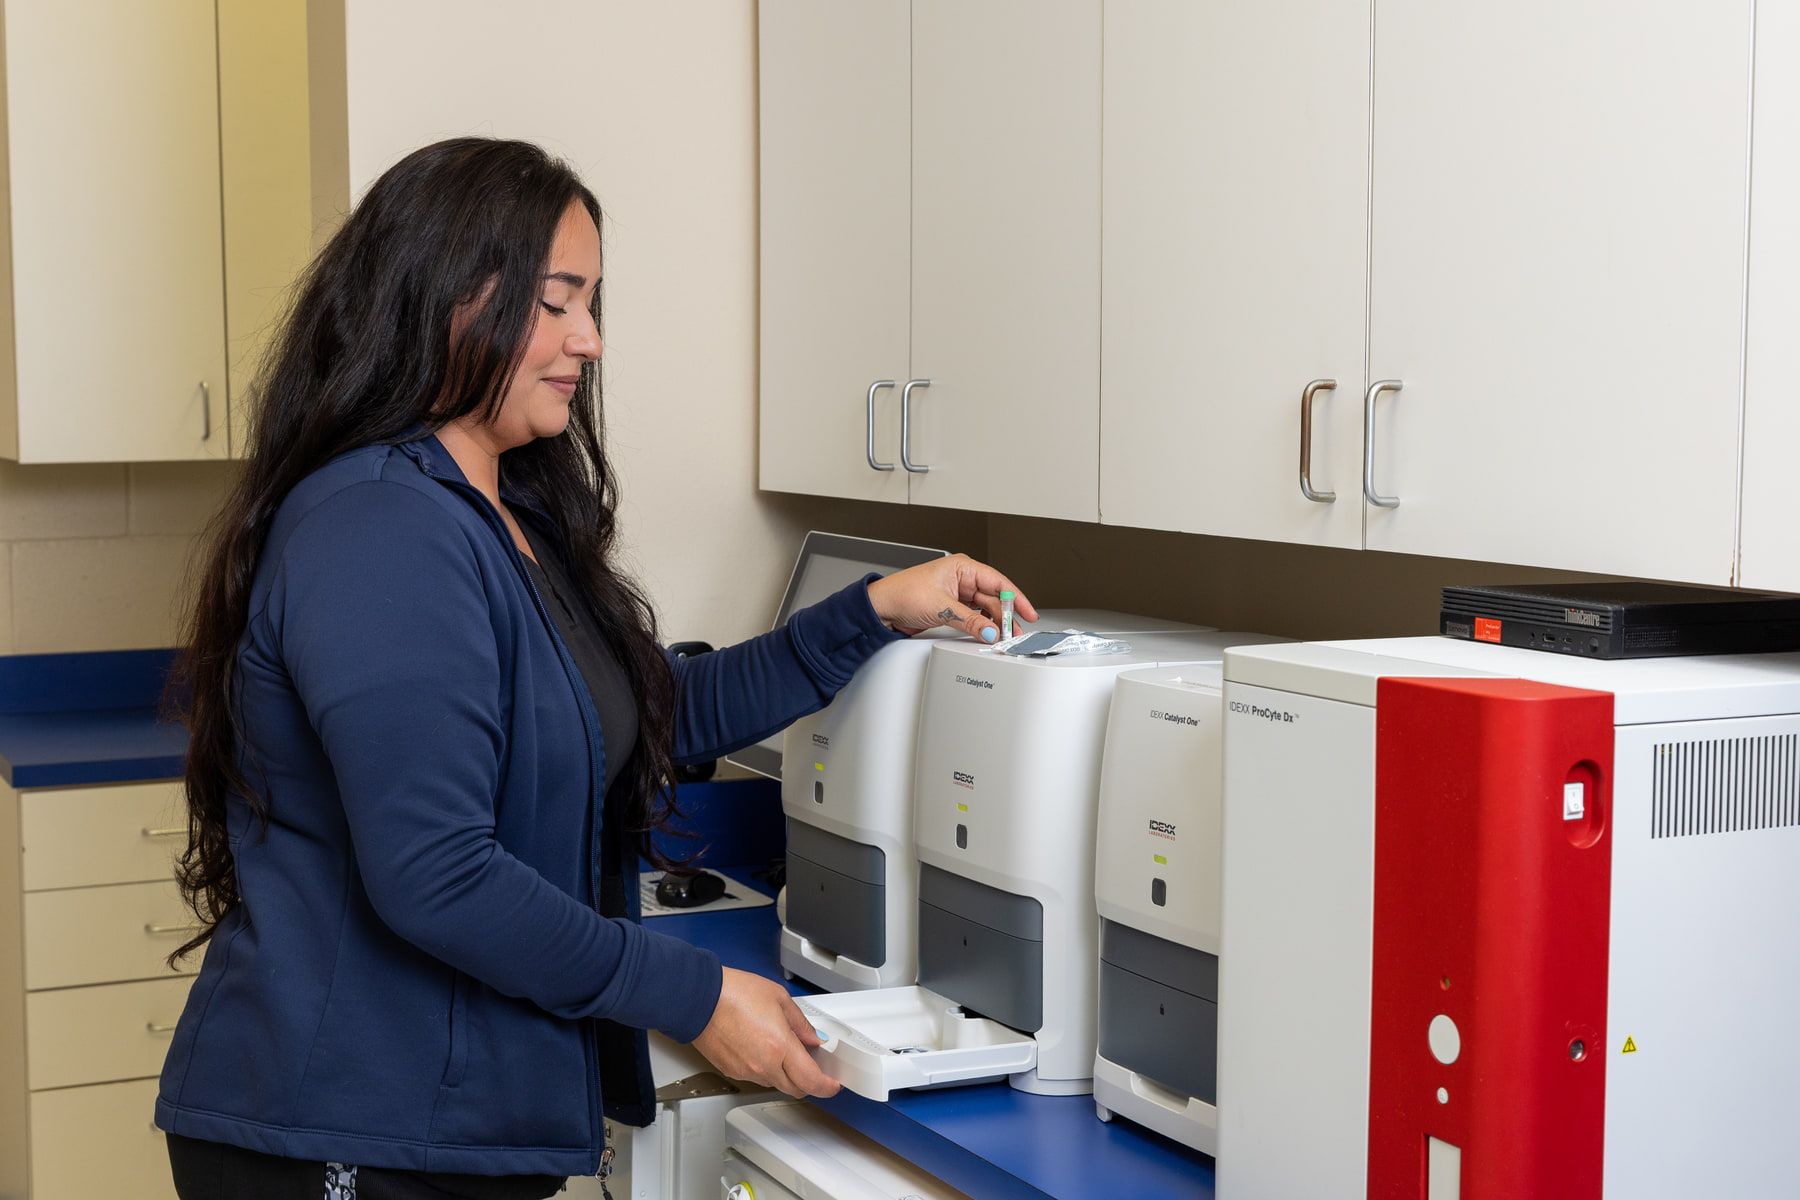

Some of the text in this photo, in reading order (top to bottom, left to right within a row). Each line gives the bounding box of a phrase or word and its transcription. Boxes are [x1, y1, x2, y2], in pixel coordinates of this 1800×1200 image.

[1565, 608, 1600, 627] ThinkCentre
[1165, 712, 1186, 724] Catalyst
[1230, 701, 1250, 714] IDEXX
[1252, 706, 1281, 721] ProCyte
[954, 771, 974, 785] IDEXX
[1150, 820, 1175, 835] IDEXX
